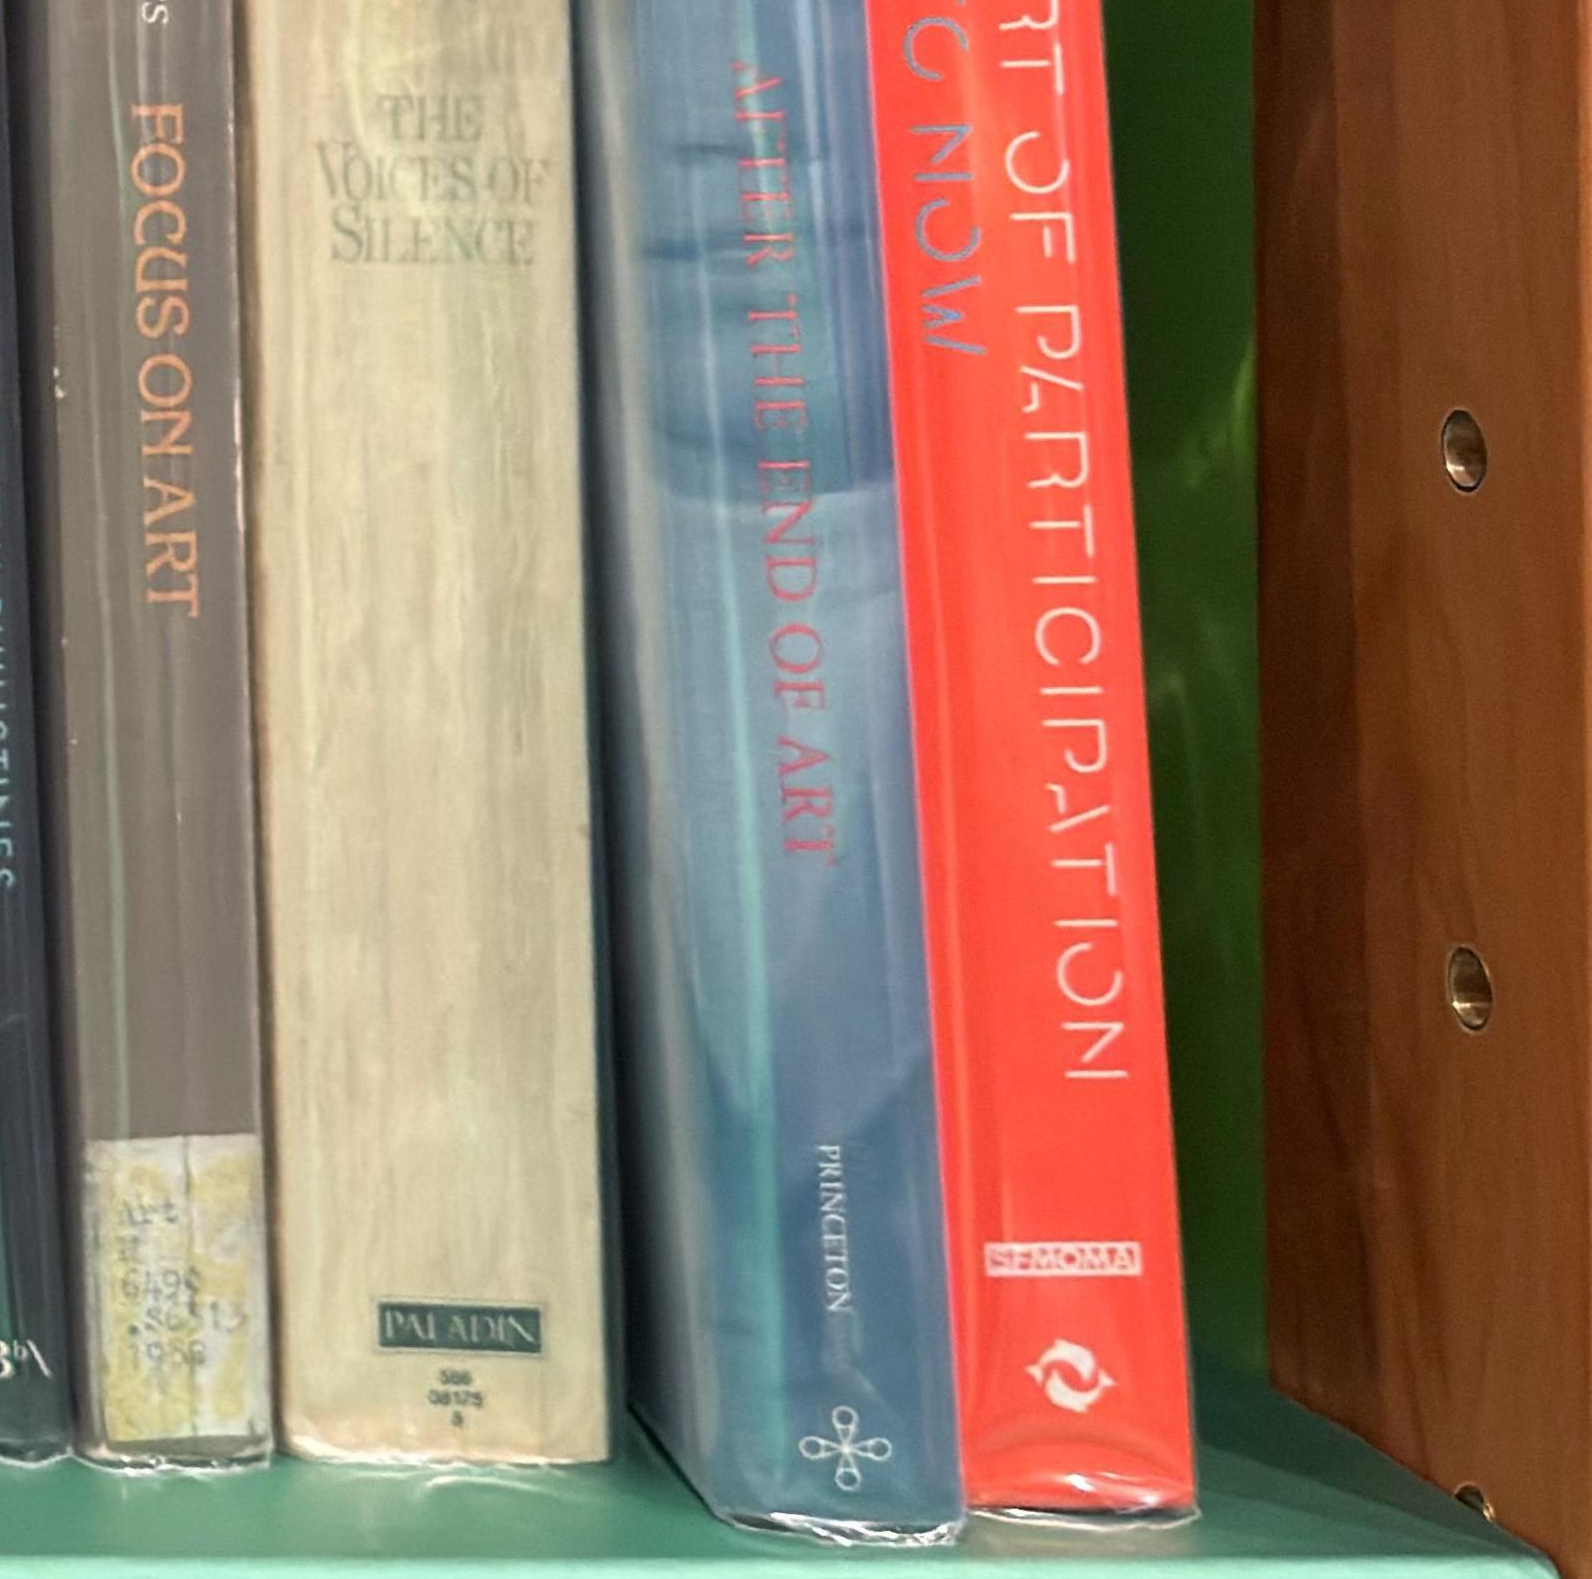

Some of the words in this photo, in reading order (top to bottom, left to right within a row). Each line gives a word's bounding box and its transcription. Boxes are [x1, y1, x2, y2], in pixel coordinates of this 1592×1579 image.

[131, 102, 189, 337] FOCUS
[1005, 130, 1078, 267] OF
[139, 352, 193, 457] ON
[141, 472, 199, 617] ART
[1017, 305, 1128, 1082] PARTICIPATION
[818, 1144, 848, 1314] PRINCETON
